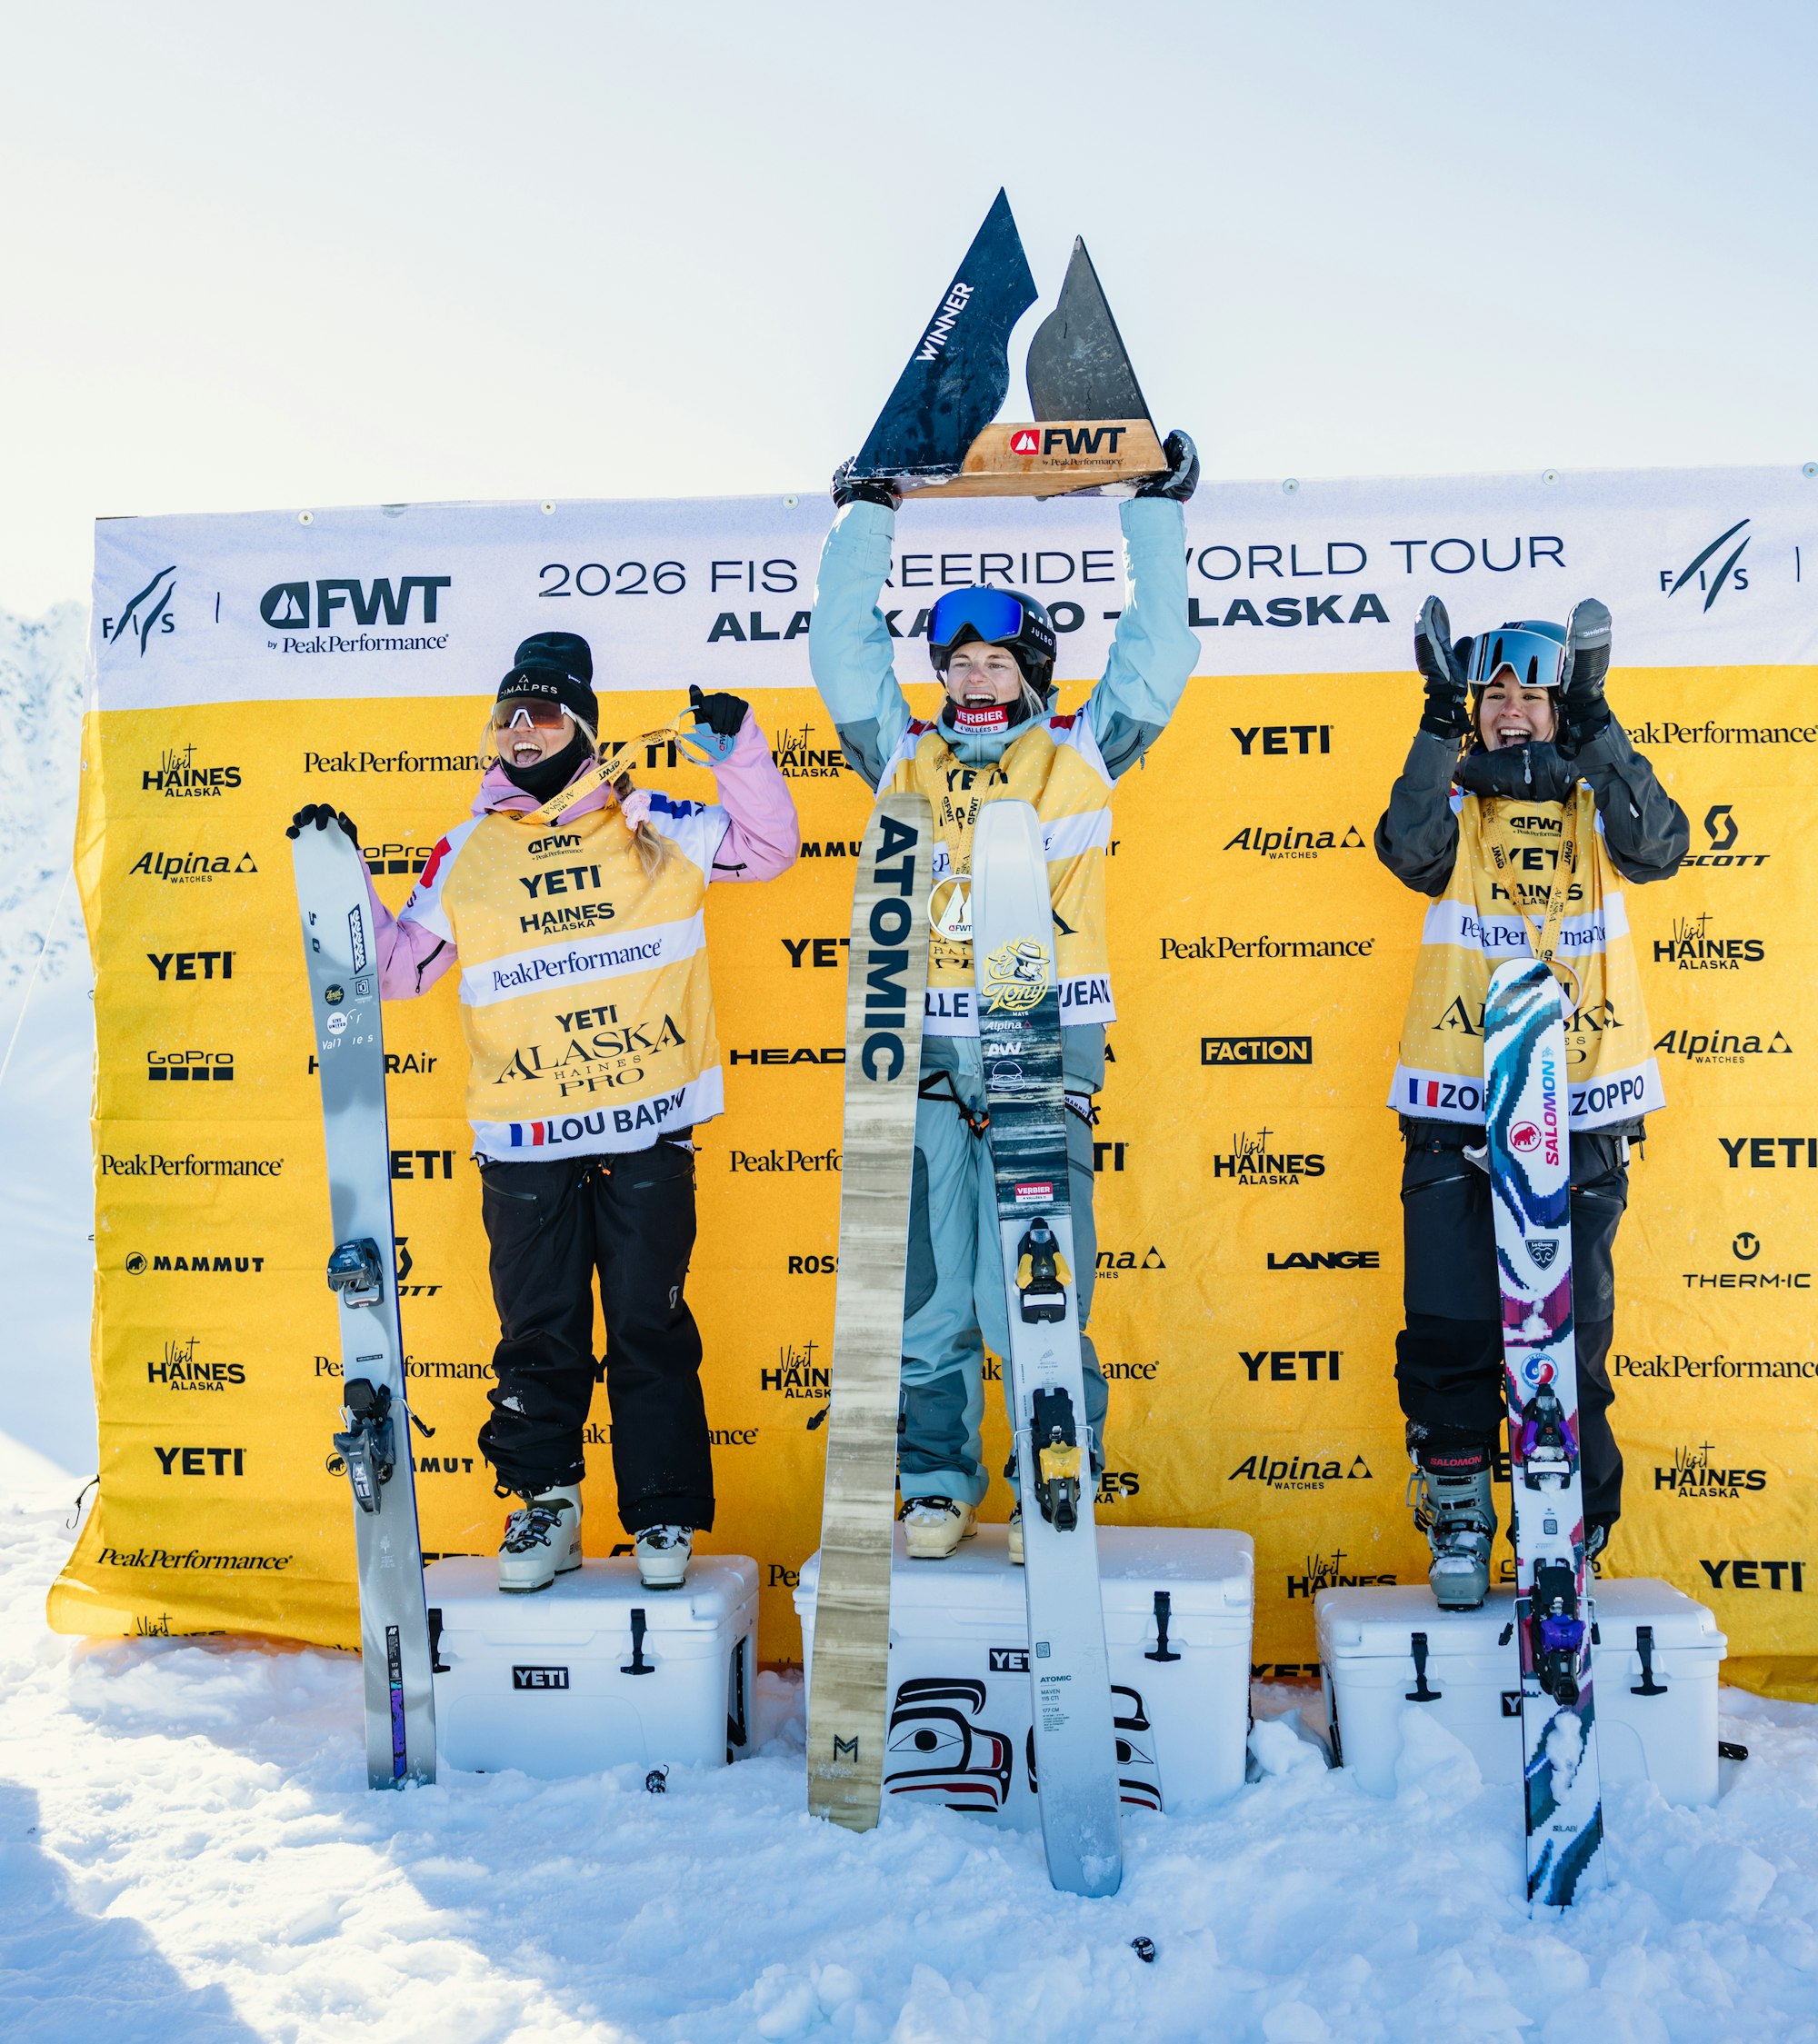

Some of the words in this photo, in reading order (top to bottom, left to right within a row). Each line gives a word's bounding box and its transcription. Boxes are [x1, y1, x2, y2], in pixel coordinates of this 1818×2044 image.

[915, 281, 974, 362] WINNER
[1044, 427, 1126, 454] FWT
[538, 560, 686, 598] 2026
[710, 559, 799, 593] FIS
[1186, 542, 1367, 582] ORLD
[1390, 535, 1566, 574] TOUR
[316, 576, 451, 627] FWT
[1188, 593, 1390, 627] LASKA
[267, 640, 278, 651] by
[281, 633, 450, 654] PeakPerformance
[1031, 627, 1053, 646] JULBO
[956, 710, 1004, 724] VERBIER
[777, 724, 813, 754] Visit
[1230, 725, 1331, 755] YETI
[1623, 723, 1816, 747] eakPerformance
[161, 743, 198, 772] Visit
[304, 751, 493, 774] PeakPerformanc
[142, 765, 242, 792] HAINES
[782, 768, 840, 778] ALASKA
[165, 786, 222, 798] ALASKA
[364, 843, 435, 859] oPro
[544, 835, 582, 852] FWT
[1223, 826, 1336, 855] Alpina
[129, 852, 230, 878] Alpina
[1268, 851, 1318, 860] WATCHES
[1677, 854, 1771, 867] SCOTT
[170, 875, 213, 884] WATCHES
[519, 865, 601, 899] YETI
[1492, 882, 1583, 901] HAINS
[520, 902, 615, 933] HAINES
[543, 919, 595, 935] ALASKA
[1673, 911, 1713, 945] Visit
[862, 814, 918, 1082] ATOMIC
[1160, 935, 1373, 959] PeakPerformance
[1654, 939, 1764, 964] HAINES
[147, 952, 232, 981] YETI
[493, 939, 662, 992] PeakPerformance
[1678, 958, 1740, 970] ALASKA
[555, 1005, 618, 1033] YETI
[984, 1021, 1022, 1032] Alpina
[147, 1051, 234, 1064] GoPro
[492, 1013, 686, 1084] ALASKA
[731, 1048, 847, 1065] HEAD
[1205, 1042, 1307, 1061] FACTION
[1654, 1030, 1763, 1061] Alpina
[554, 1055, 642, 1080] HAINES
[560, 1068, 644, 1098] PRO
[1064, 1097, 1087, 1116] MAMMUT
[1543, 1062, 1559, 1166] SALOMON
[547, 1112, 605, 1143] LOU
[1234, 1127, 1273, 1159] Visit
[1719, 1138, 1818, 1171] YETI
[101, 1154, 282, 1175] PeakPerformance
[391, 1151, 452, 1179] ETI
[1214, 1154, 1325, 1178] HAINES
[1017, 1186, 1050, 1194] VERBIER
[1238, 1173, 1299, 1185] ALASKA
[154, 1257, 264, 1272] MAMMUT
[1268, 1252, 1379, 1269] LANGE
[1683, 1273, 1811, 1289] THERM-IC
[165, 1337, 200, 1363] Visit
[780, 1341, 818, 1373] Visit
[147, 1361, 245, 1384] HAINES
[1239, 1351, 1338, 1381] YETI
[170, 1381, 224, 1391] ALASKA
[154, 1448, 244, 1475] YETI
[1430, 1456, 1482, 1466] SALOMON
[1675, 1441, 1715, 1471] Visit
[1228, 1456, 1342, 1486] Alpina
[1654, 1469, 1766, 1491] HAINES
[1678, 1487, 1739, 1498] ALASKA
[95, 1548, 290, 1570] PeakPerformance
[1307, 1550, 1347, 1578] Visit
[1700, 1560, 1803, 1592] YETI
[516, 1670, 565, 1687] YETI
